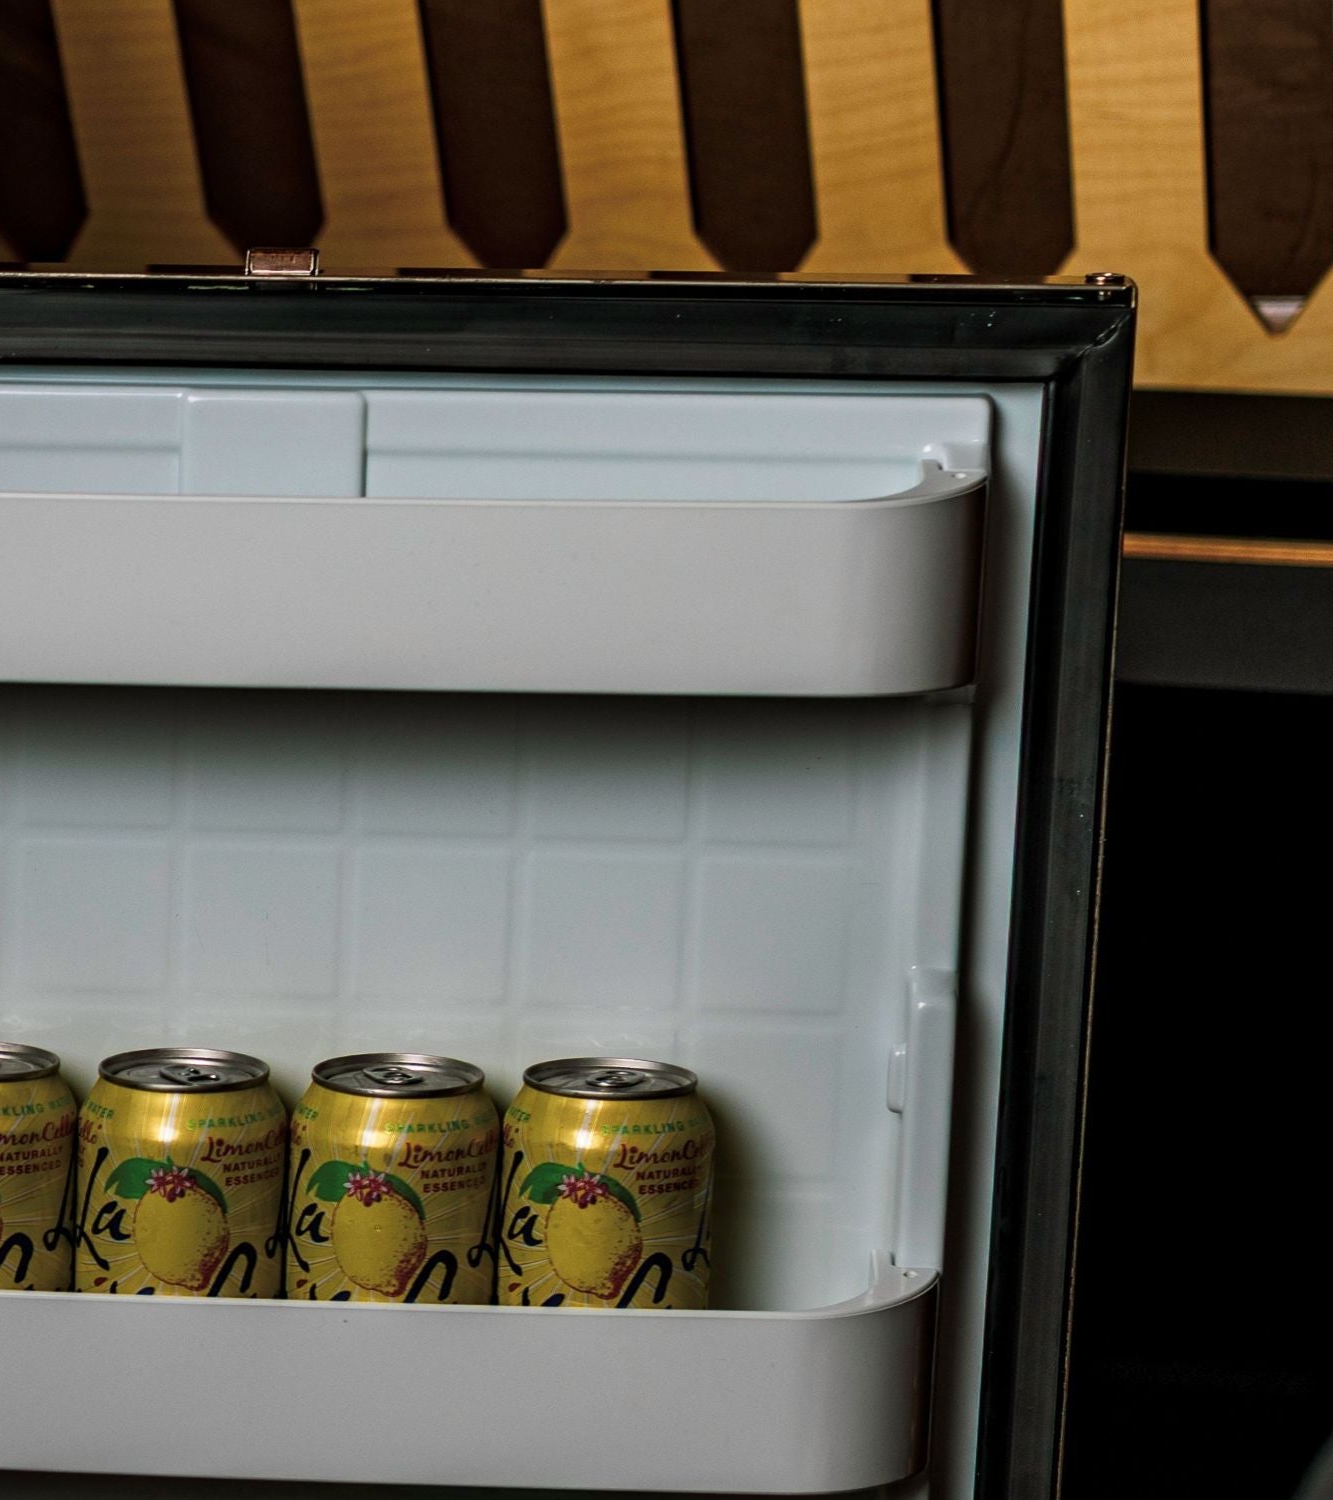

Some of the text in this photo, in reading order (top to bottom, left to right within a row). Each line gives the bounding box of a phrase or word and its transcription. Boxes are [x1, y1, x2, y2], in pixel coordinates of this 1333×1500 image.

[187, 1111, 265, 1129] SPARKLING
[386, 1119, 470, 1133] SPARKLING
[601, 1120, 684, 1134] SPARKLING
[223, 1153, 281, 1173] NATURALLY
[420, 1161, 487, 1179] NATURALLY
[225, 1167, 279, 1186] ESSENCED
[636, 1165, 701, 1181] NATURALLY
[423, 1175, 485, 1193] ESSENCED
[638, 1178, 700, 1195] ESSENCED
